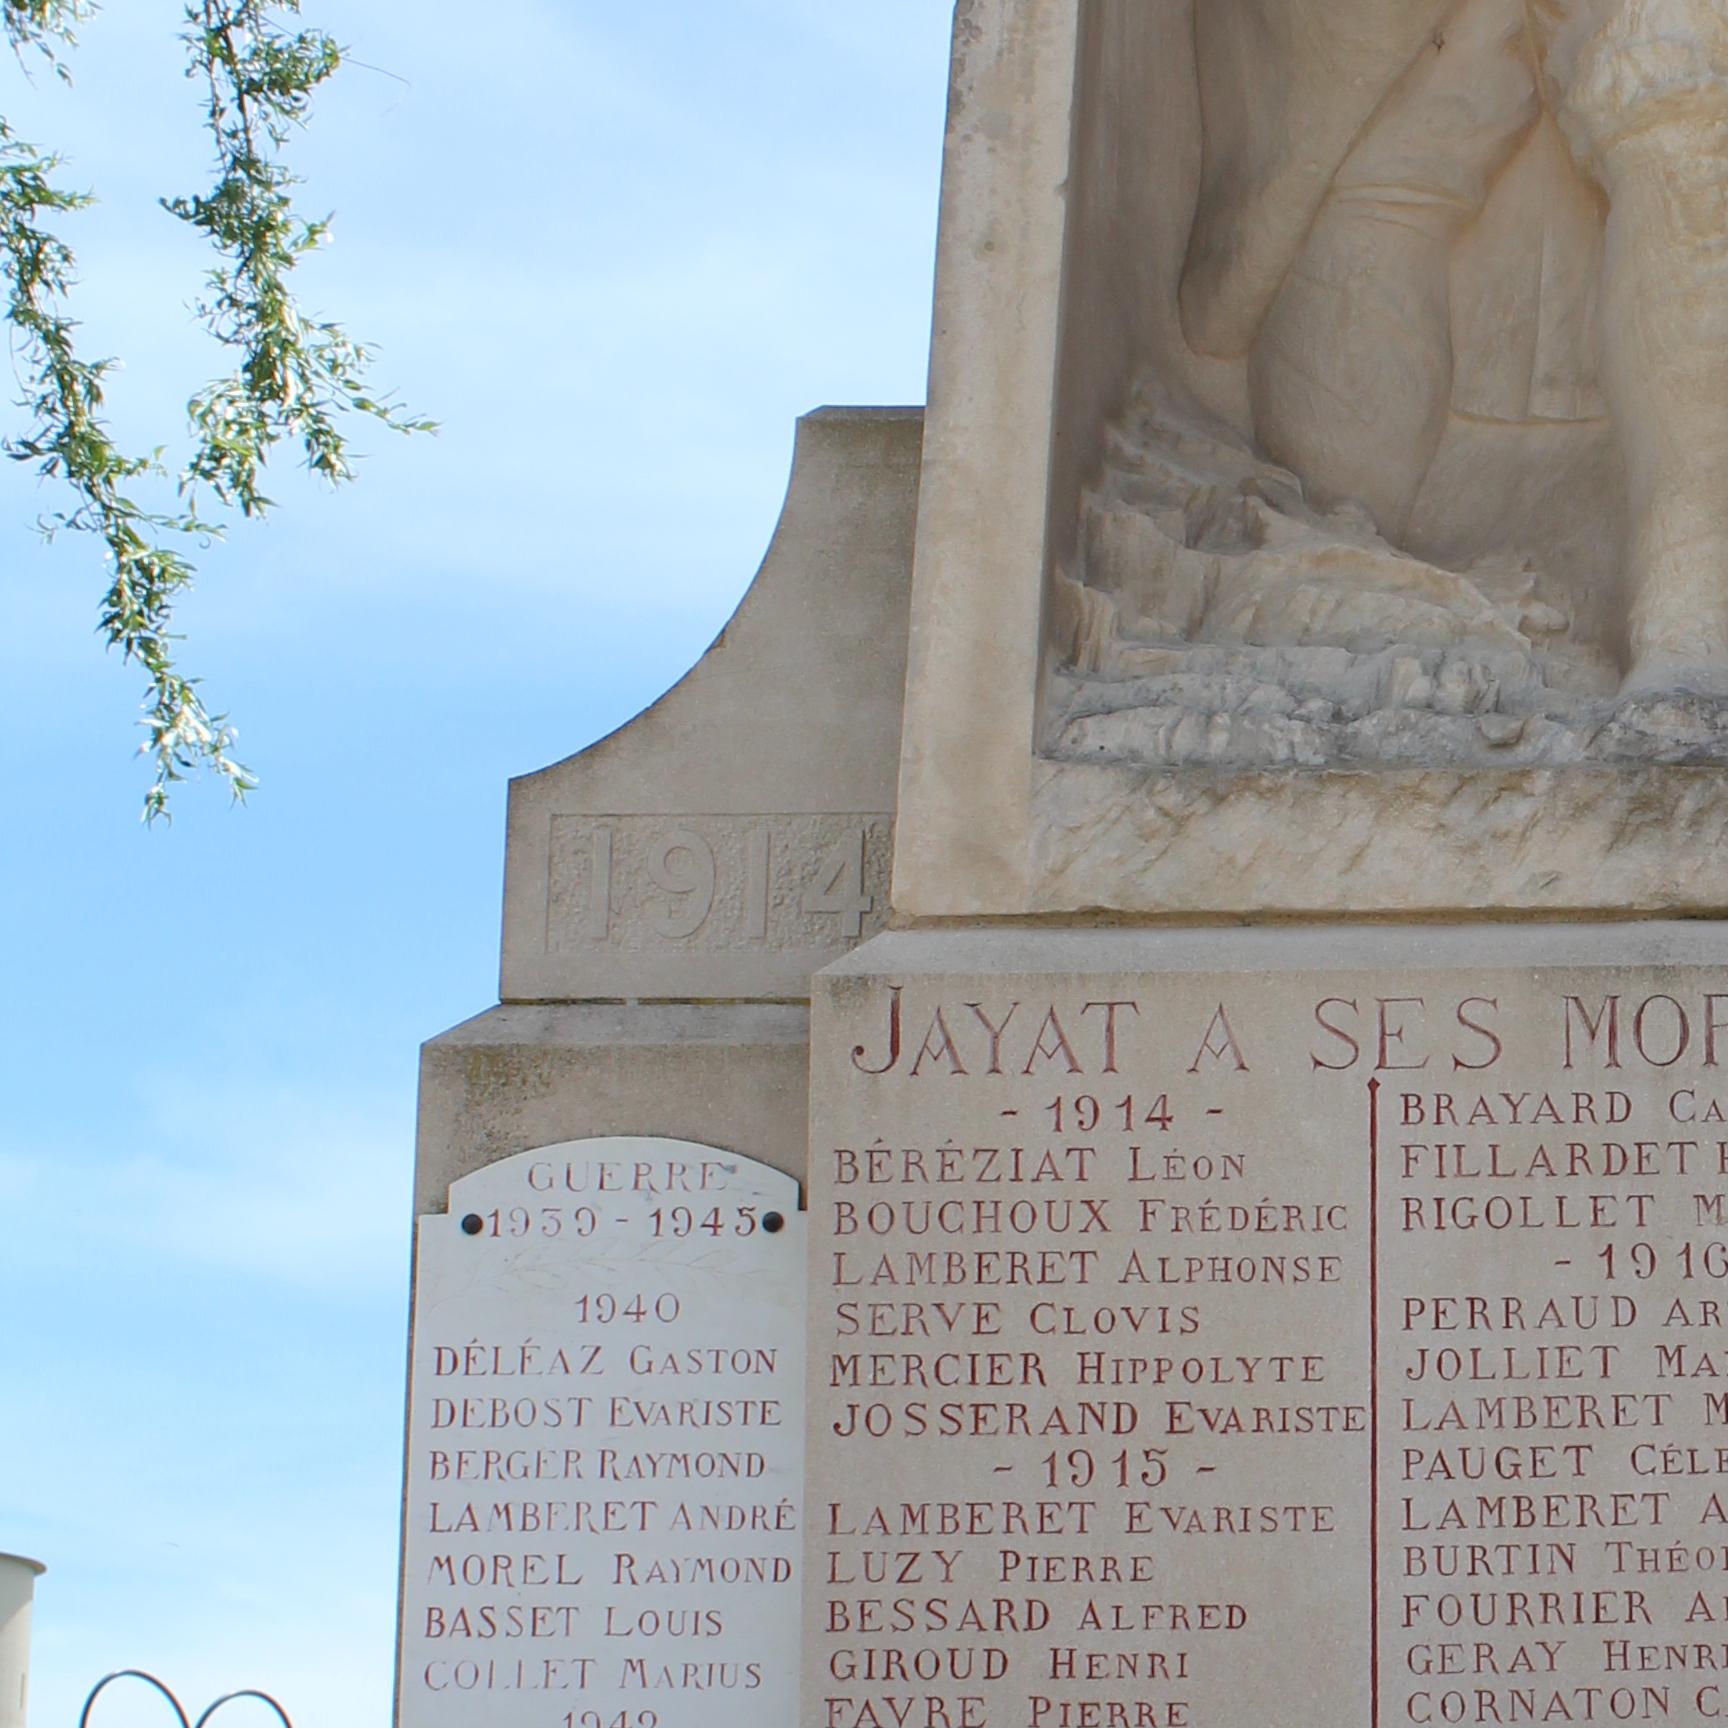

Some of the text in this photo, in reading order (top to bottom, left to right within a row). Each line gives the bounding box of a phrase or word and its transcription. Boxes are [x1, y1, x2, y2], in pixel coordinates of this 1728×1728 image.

[591, 826, 873, 940] 1914
[851, 985, 1139, 1077] JAYAT
[1187, 1002, 1250, 1074] A
[1311, 997, 1502, 1072] SES
[1400, 1091, 1631, 1125] BRAYARD
[834, 1138, 1096, 1184] BÉRÉZIAT
[1401, 1141, 1697, 1179] FILLARDET
[528, 1162, 724, 1196] GUERRE
[834, 1199, 1111, 1235] BOUCHOUX
[1401, 1195, 1654, 1232] RIGOLLET
[833, 1251, 1098, 1286] LAMBERET
[576, 1294, 679, 1323] 1940
[837, 1302, 1001, 1336] SERVE
[1403, 1296, 1636, 1330] PERRAUD
[830, 1353, 1046, 1388] MERCIER
[1406, 1345, 1618, 1381] JOLLIET
[431, 1398, 592, 1428] DEBOST
[833, 1402, 1137, 1437] JOSSERAND
[1402, 1394, 1672, 1431] LAMBERET
[1403, 1444, 1593, 1480] PAUGET
[430, 1501, 657, 1534] LAMBERET
[829, 1502, 1096, 1535] LAMBERET
[1402, 1493, 1669, 1530] LAMBERET
[827, 1550, 962, 1584] LUZY
[1405, 1543, 1575, 1576] BURTIN
[425, 1606, 578, 1638] BASSET
[825, 1598, 1049, 1633] BESSARD
[1402, 1591, 1651, 1627] FOURRIER
[830, 1648, 1008, 1681] GIROUD
[1407, 1641, 1565, 1675] GERAY
[1407, 1687, 1669, 1723] CORNATON
